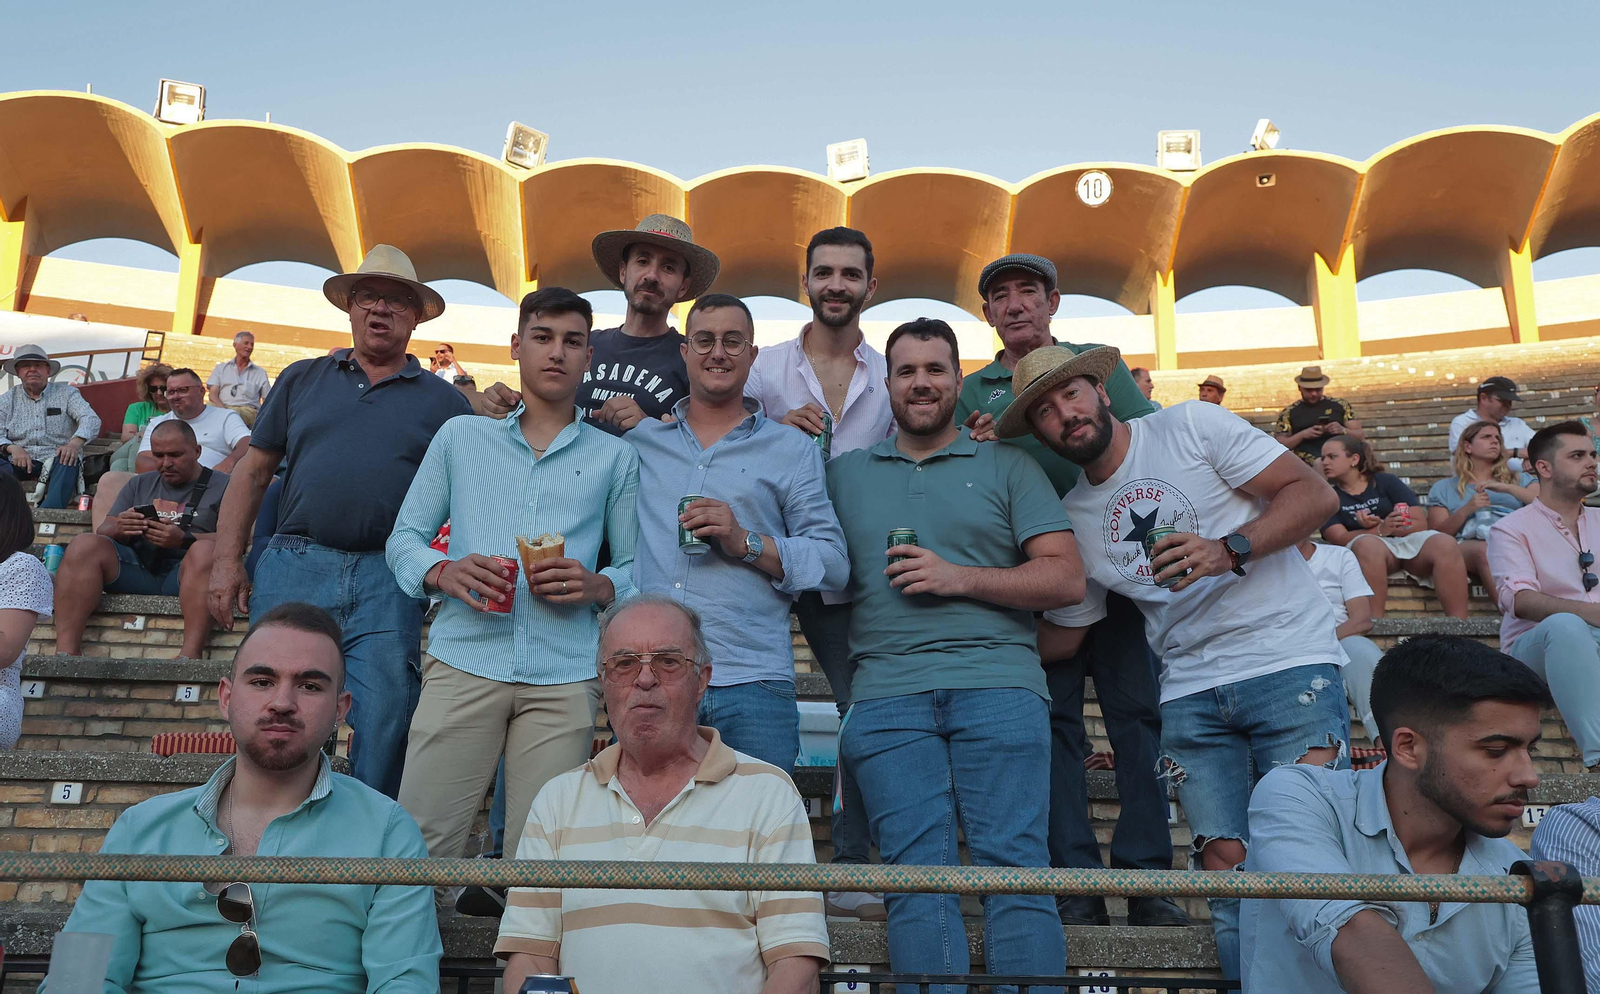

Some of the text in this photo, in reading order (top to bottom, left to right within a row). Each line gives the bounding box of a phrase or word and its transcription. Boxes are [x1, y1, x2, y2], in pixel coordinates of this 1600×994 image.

[1083, 178, 1102, 199] 10
[580, 363, 674, 403] ASADENA
[1110, 487, 1165, 543] CONVERSE
[44, 524, 50, 533] 2
[1122, 543, 1142, 568] Chuck
[1135, 564, 1154, 577] AL
[28, 683, 37, 695] 4
[184, 687, 193, 699] 5
[62, 784, 72, 800] 5
